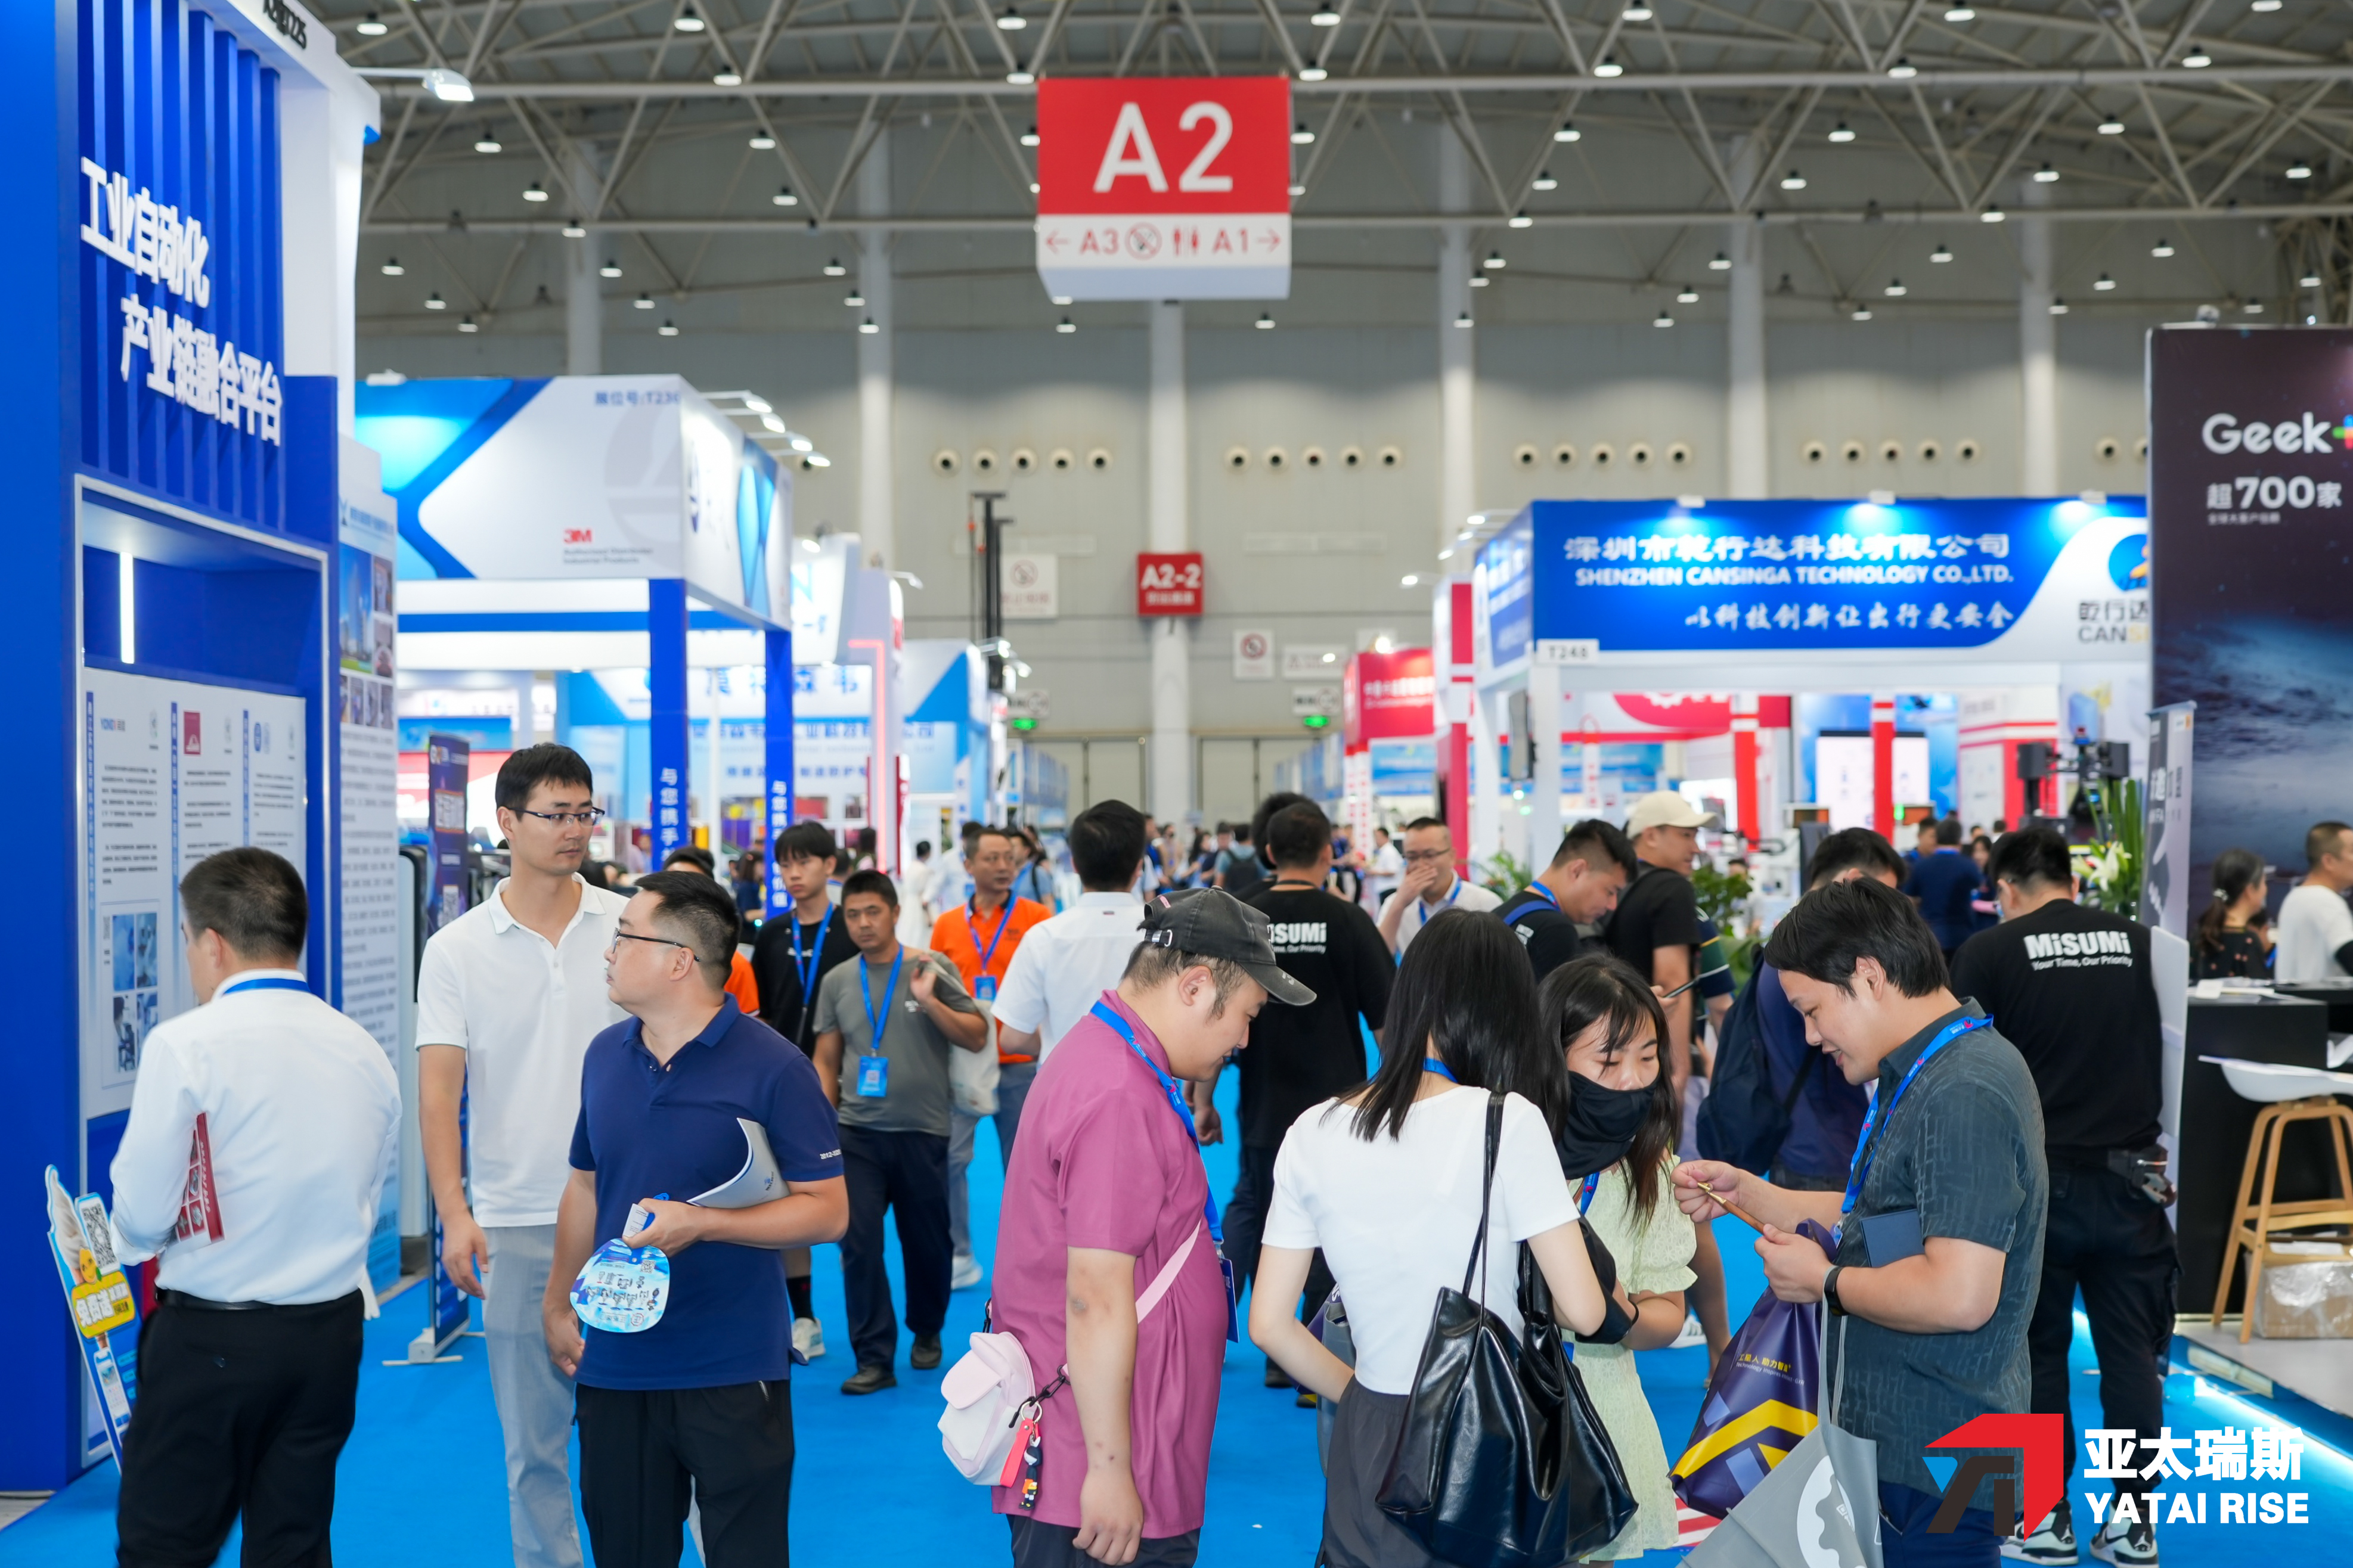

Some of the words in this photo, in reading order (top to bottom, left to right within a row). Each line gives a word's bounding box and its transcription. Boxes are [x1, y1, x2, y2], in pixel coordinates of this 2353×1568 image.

[1093, 101, 1233, 192] A2
[80, 156, 210, 309] 工业自动化
[1080, 228, 1119, 255] A3
[1212, 228, 1249, 254] A1
[120, 294, 283, 447] 产业链融合平台
[2206, 476, 2342, 509] 超700家
[563, 529, 593, 543] 3M
[1564, 533, 2010, 562] 深圳市乾行达科技有限公司
[1140, 562, 1202, 590] A2-2
[1575, 567, 1684, 586] SHENZHEN
[1685, 566, 1791, 585] CANSINGA
[1795, 564, 1929, 584] TECHNOLOGY
[1685, 601, 2014, 631] 以科技创新让出行更安全
[1548, 645, 1589, 660] T248
[2023, 930, 2132, 960] MiSUMi
[2081, 956, 2100, 967] Our
